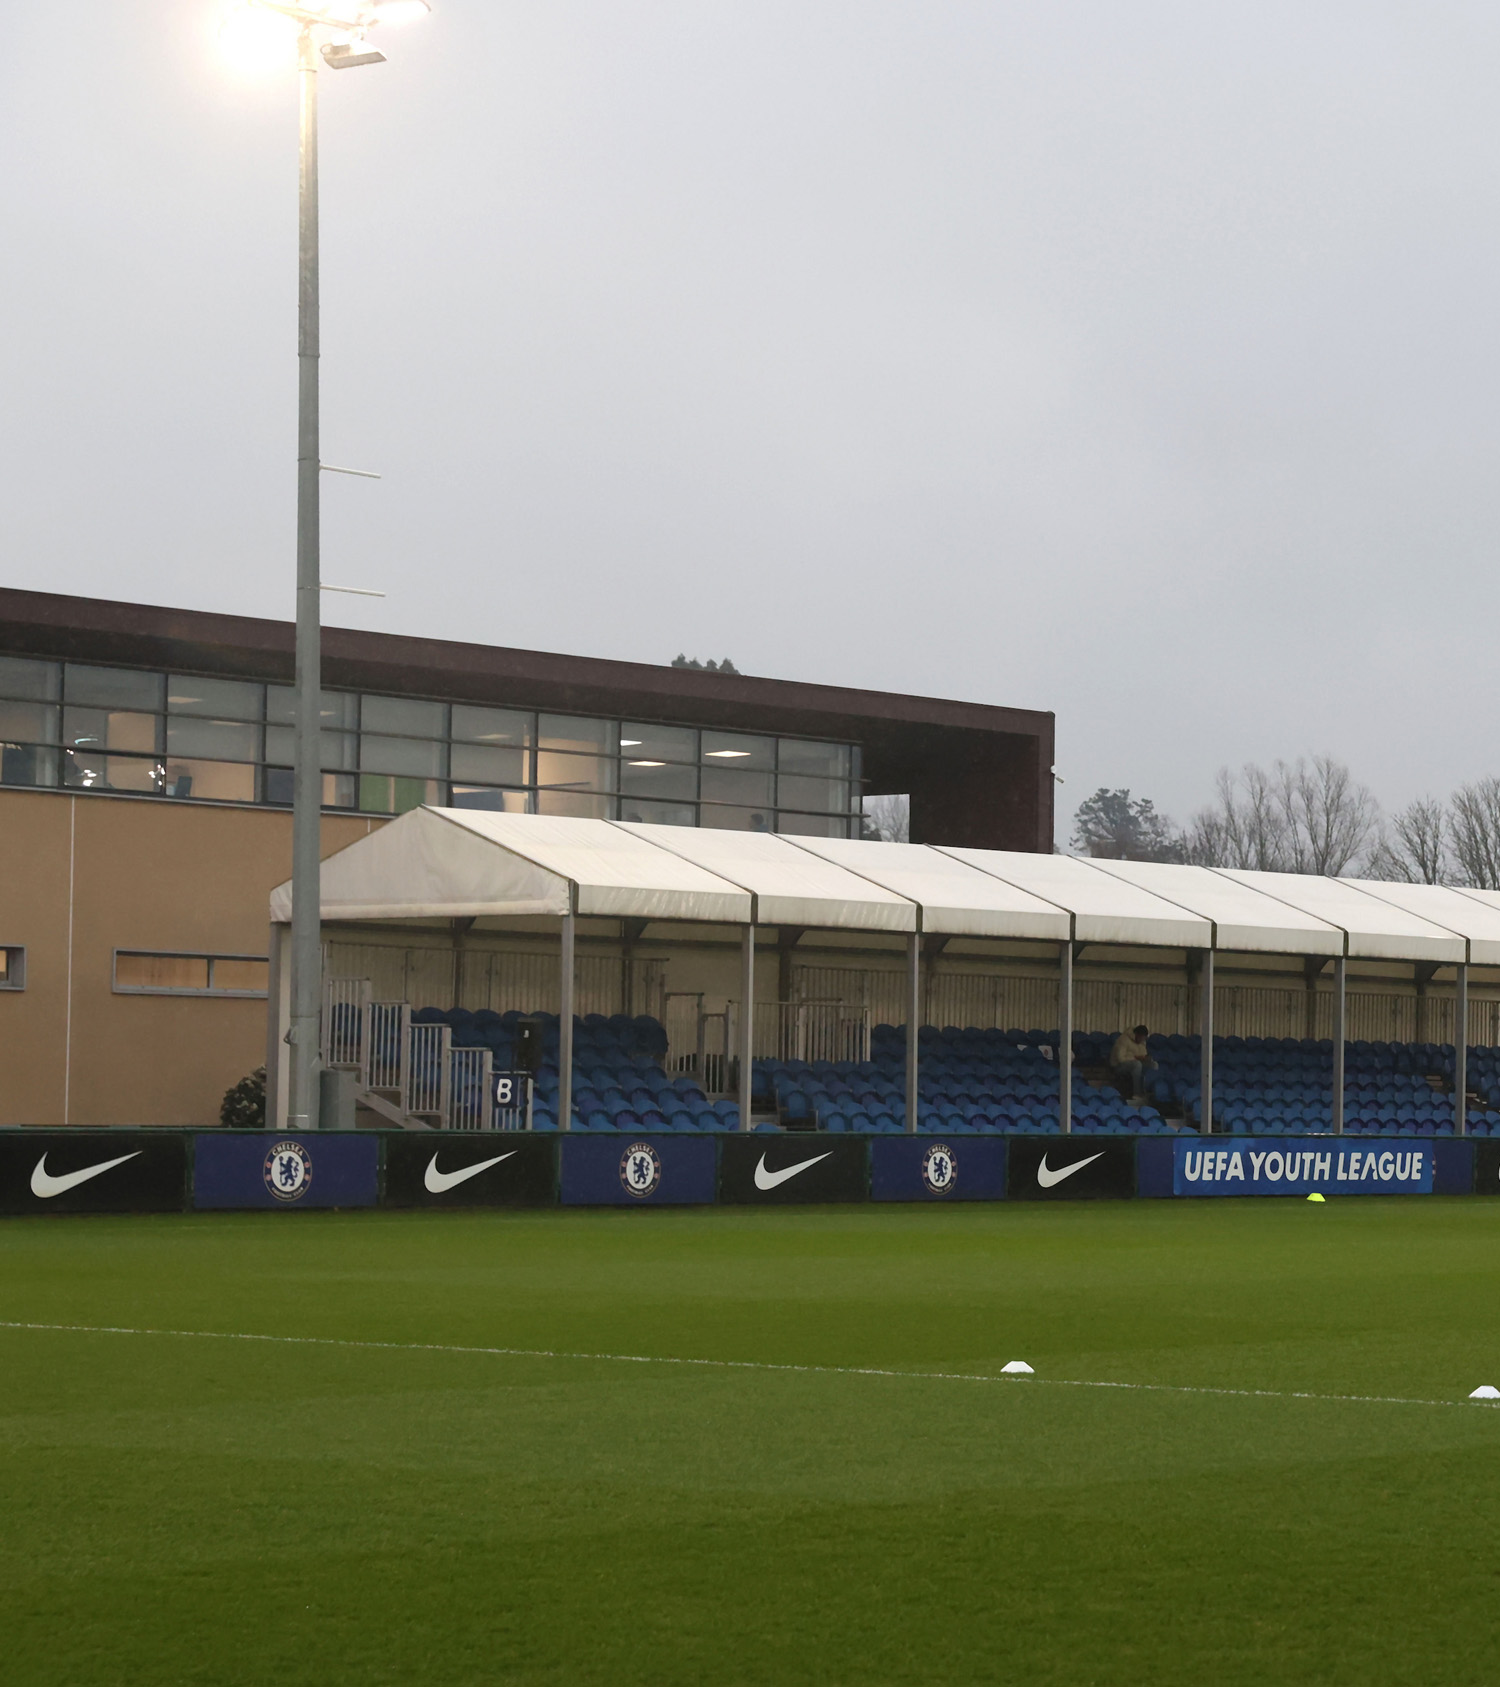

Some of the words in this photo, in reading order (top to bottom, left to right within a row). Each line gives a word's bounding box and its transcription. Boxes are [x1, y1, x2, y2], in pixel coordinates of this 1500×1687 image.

[497, 1078, 512, 1104] B
[272, 1143, 304, 1156] CHELSEA
[1184, 1151, 1245, 1181] UEFA
[1249, 1151, 1332, 1181] YOUTH
[1336, 1152, 1423, 1181] LEAGUE
